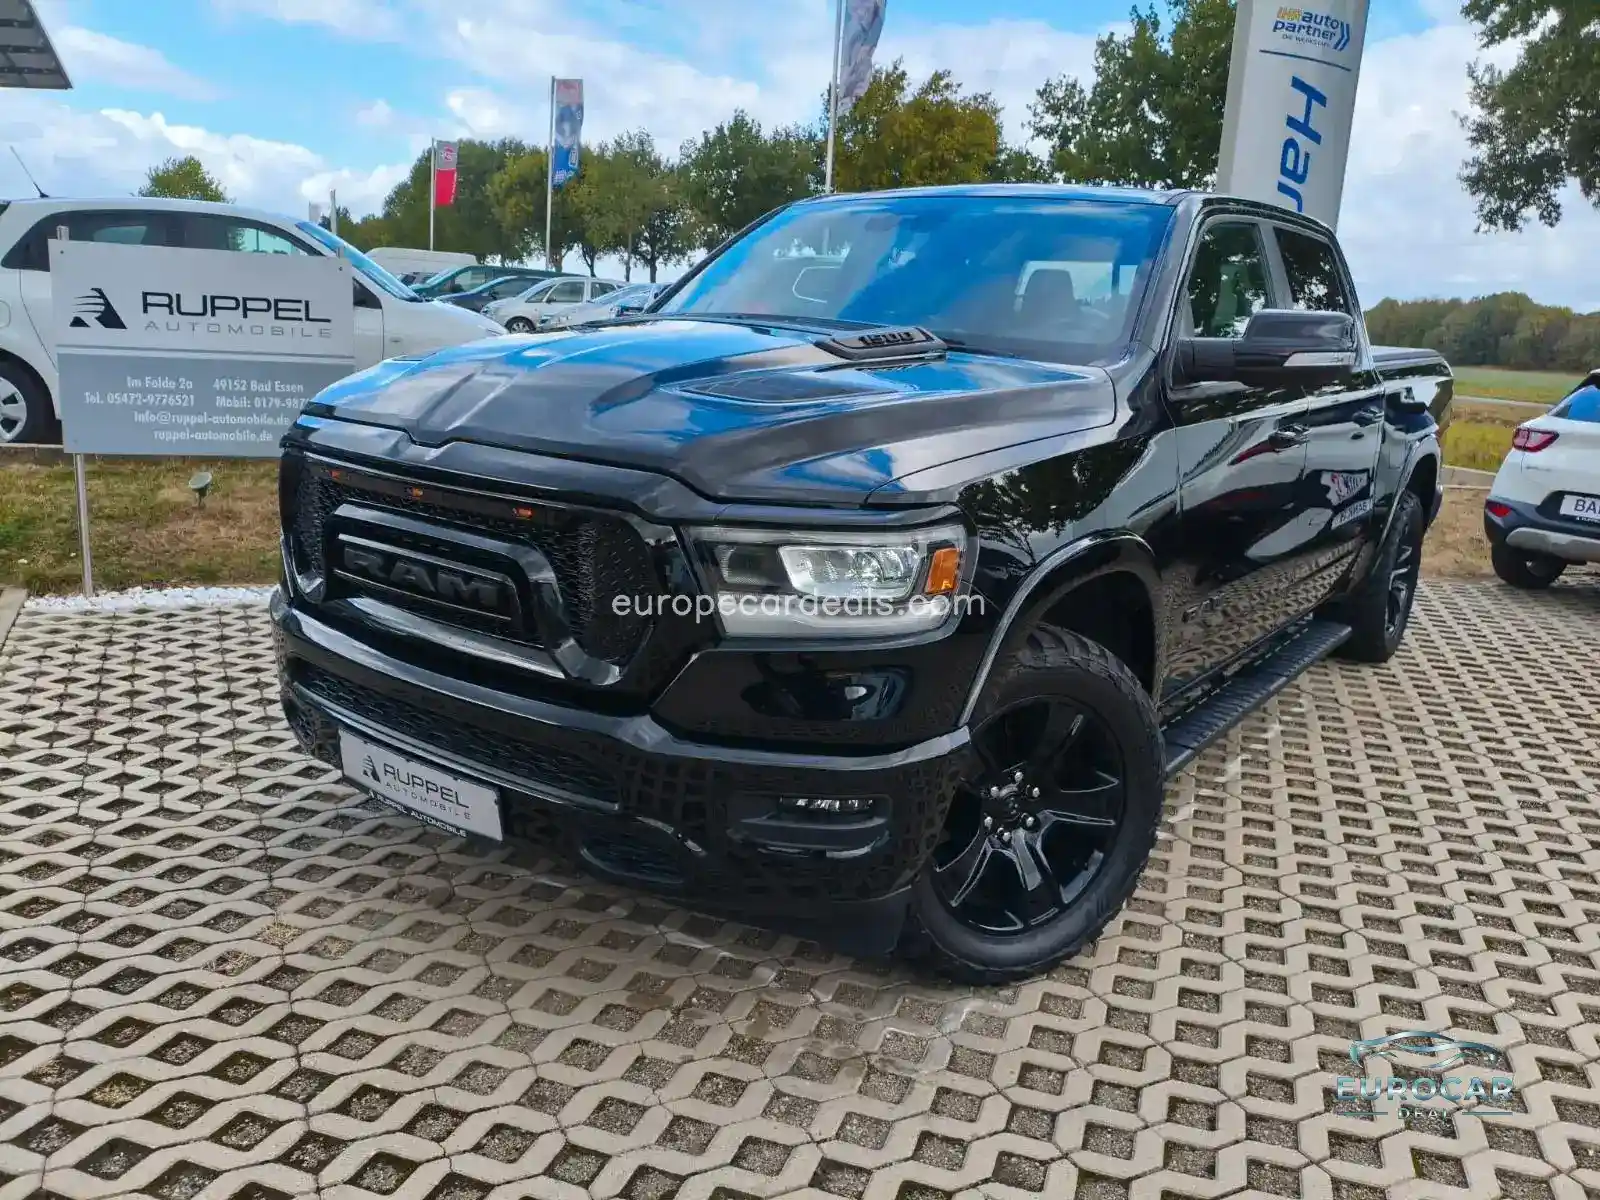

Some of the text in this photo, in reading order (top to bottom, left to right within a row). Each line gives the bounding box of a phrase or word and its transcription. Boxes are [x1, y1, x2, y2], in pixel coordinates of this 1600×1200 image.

[1272, 20, 1336, 40] partner
[1302, 11, 1340, 30] auto
[141, 291, 332, 323] RUPPEL
[144, 320, 333, 339] AUTOMOBILE
[127, 375, 142, 388] Im
[179, 377, 193, 390] 2a
[213, 378, 304, 393] 49152 Bad Essen
[84, 391, 104, 404] Tel.
[215, 395, 251, 408] Mobil:
[1574, 498, 1600, 515] BA
[343, 546, 500, 606] RAM
[383, 762, 470, 809] RUPPEL
[385, 781, 472, 820] AUTOMOBILE
[410, 810, 468, 838] AUTOMOBILE
